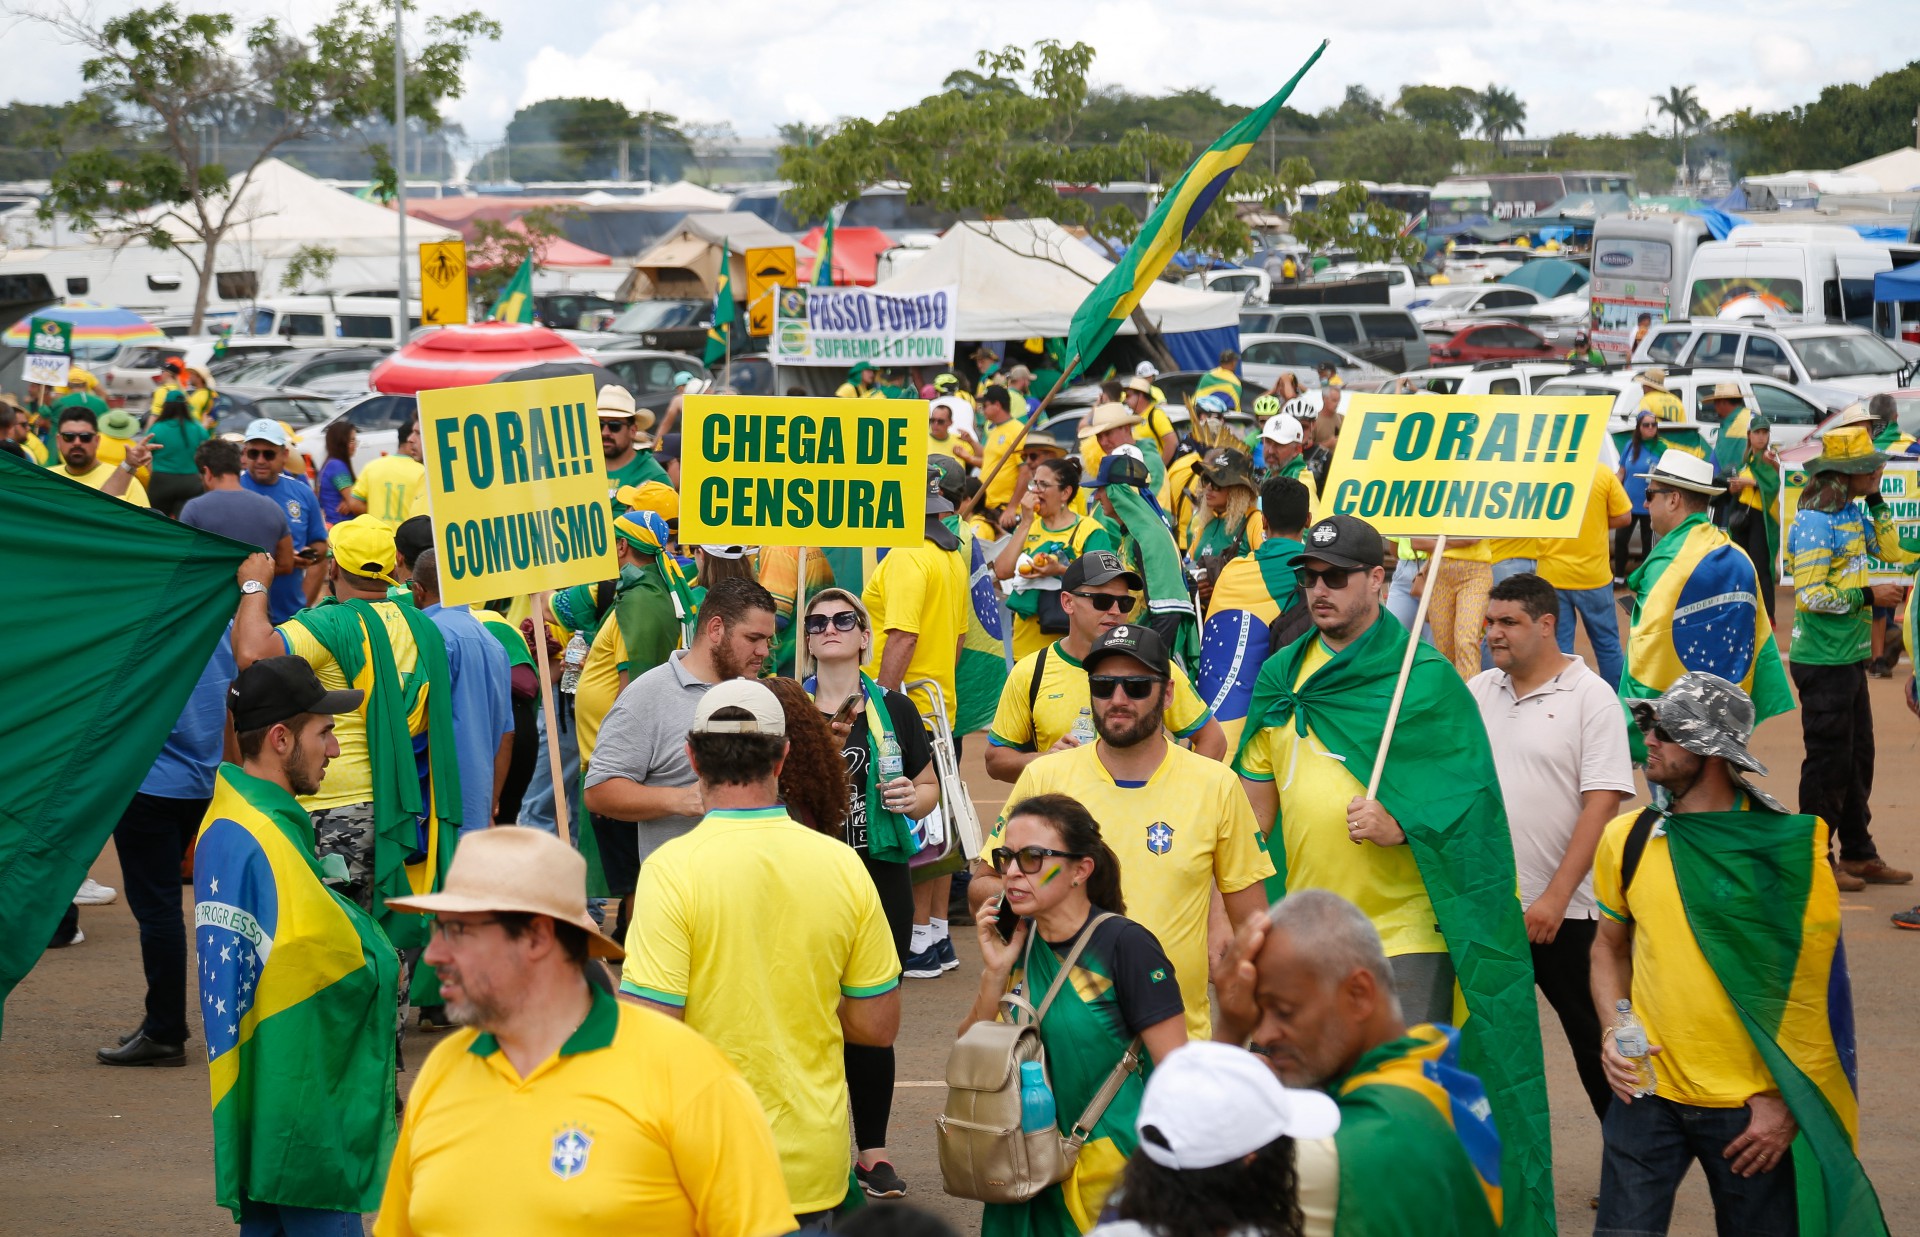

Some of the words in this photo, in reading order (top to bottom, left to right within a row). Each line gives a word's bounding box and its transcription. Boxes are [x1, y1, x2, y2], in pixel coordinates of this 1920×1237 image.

[810, 293, 871, 331] PASSO
[877, 291, 947, 331] FUNDO
[34, 333, 65, 350] SOS
[816, 336, 879, 358] SUPREMO
[895, 336, 904, 357] O
[435, 403, 593, 493] FORA!!!
[702, 413, 845, 465] CHEGA
[856, 417, 908, 465] DE
[1352, 411, 1590, 462] FORA!!!
[699, 476, 905, 528] CENSURA
[1333, 479, 1575, 520] COMUNISMO
[445, 501, 608, 580] COMUNISMO
[1683, 600, 1714, 613] ORDEM
[1239, 614, 1250, 647] ORDEM
[201, 905, 263, 947] PROGRESSO
